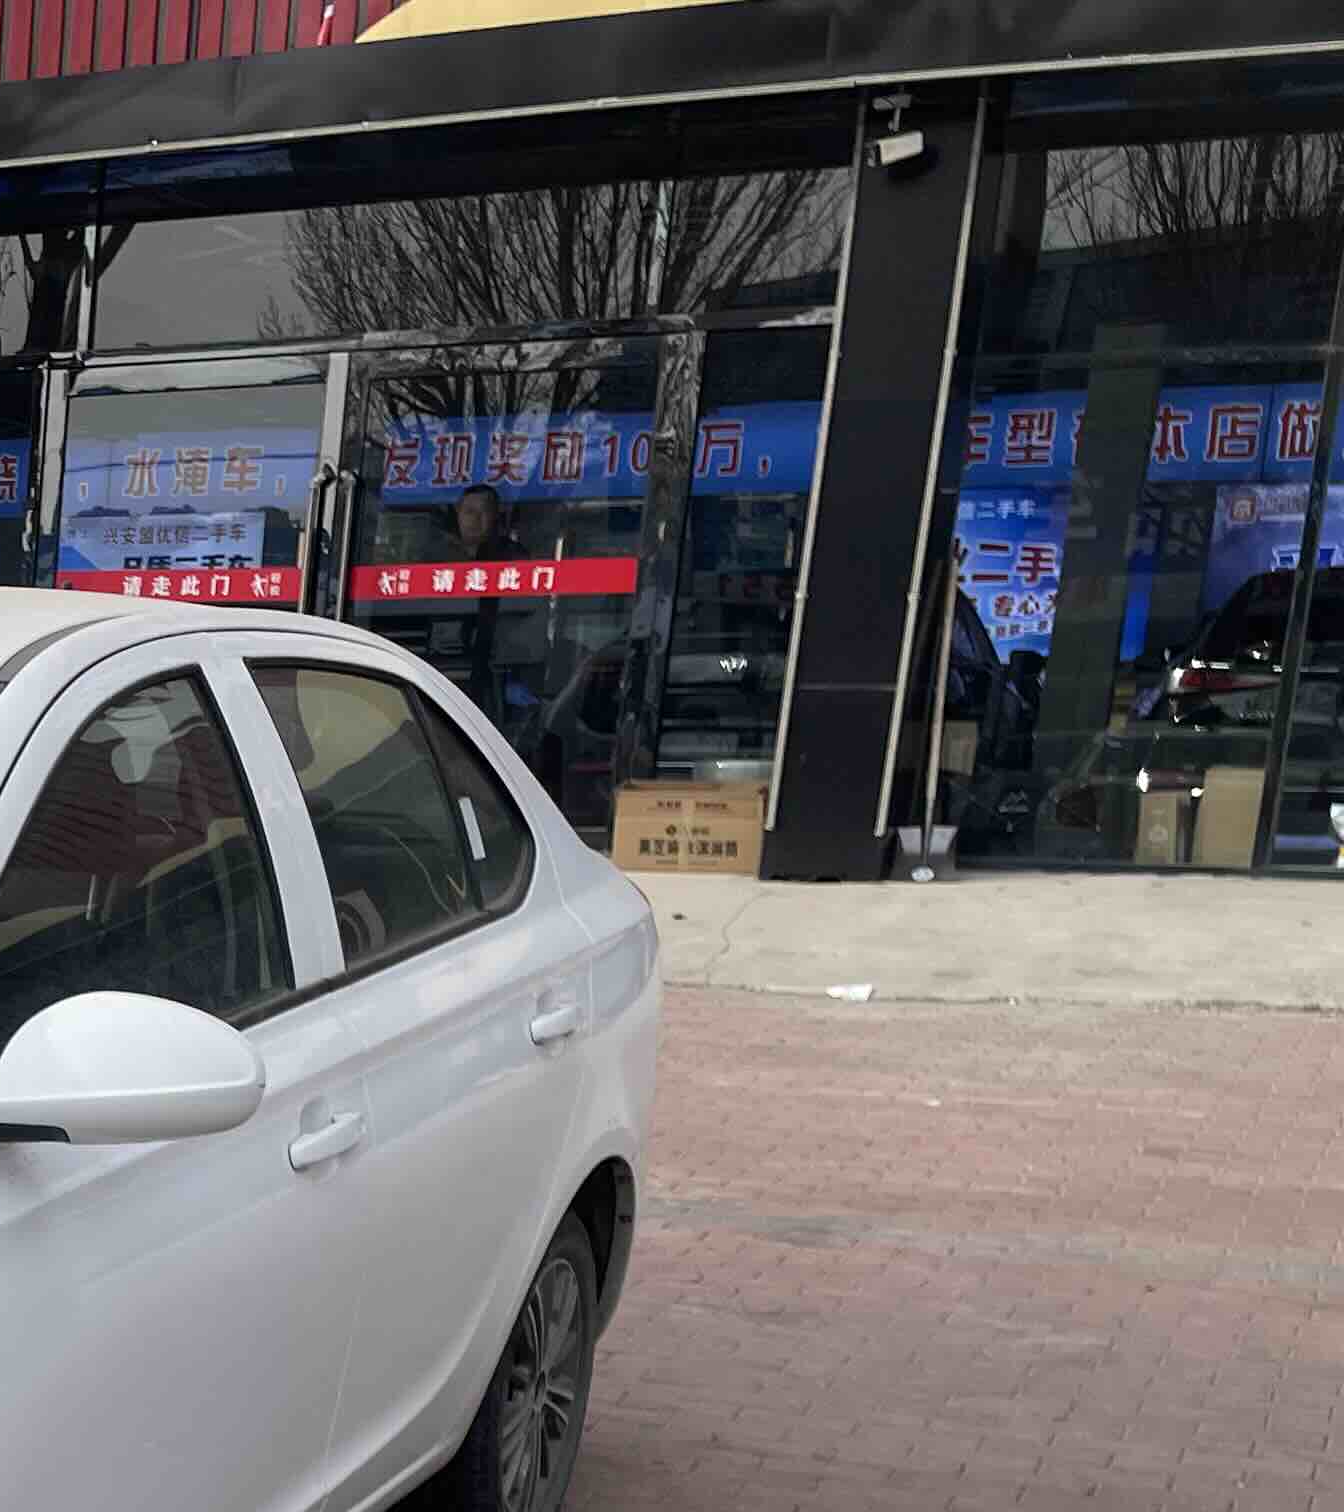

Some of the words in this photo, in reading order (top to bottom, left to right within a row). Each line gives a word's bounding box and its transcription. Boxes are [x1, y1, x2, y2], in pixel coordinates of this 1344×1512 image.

[122, 574, 231, 597] 请走此门
[432, 566, 560, 592] 请走此门
